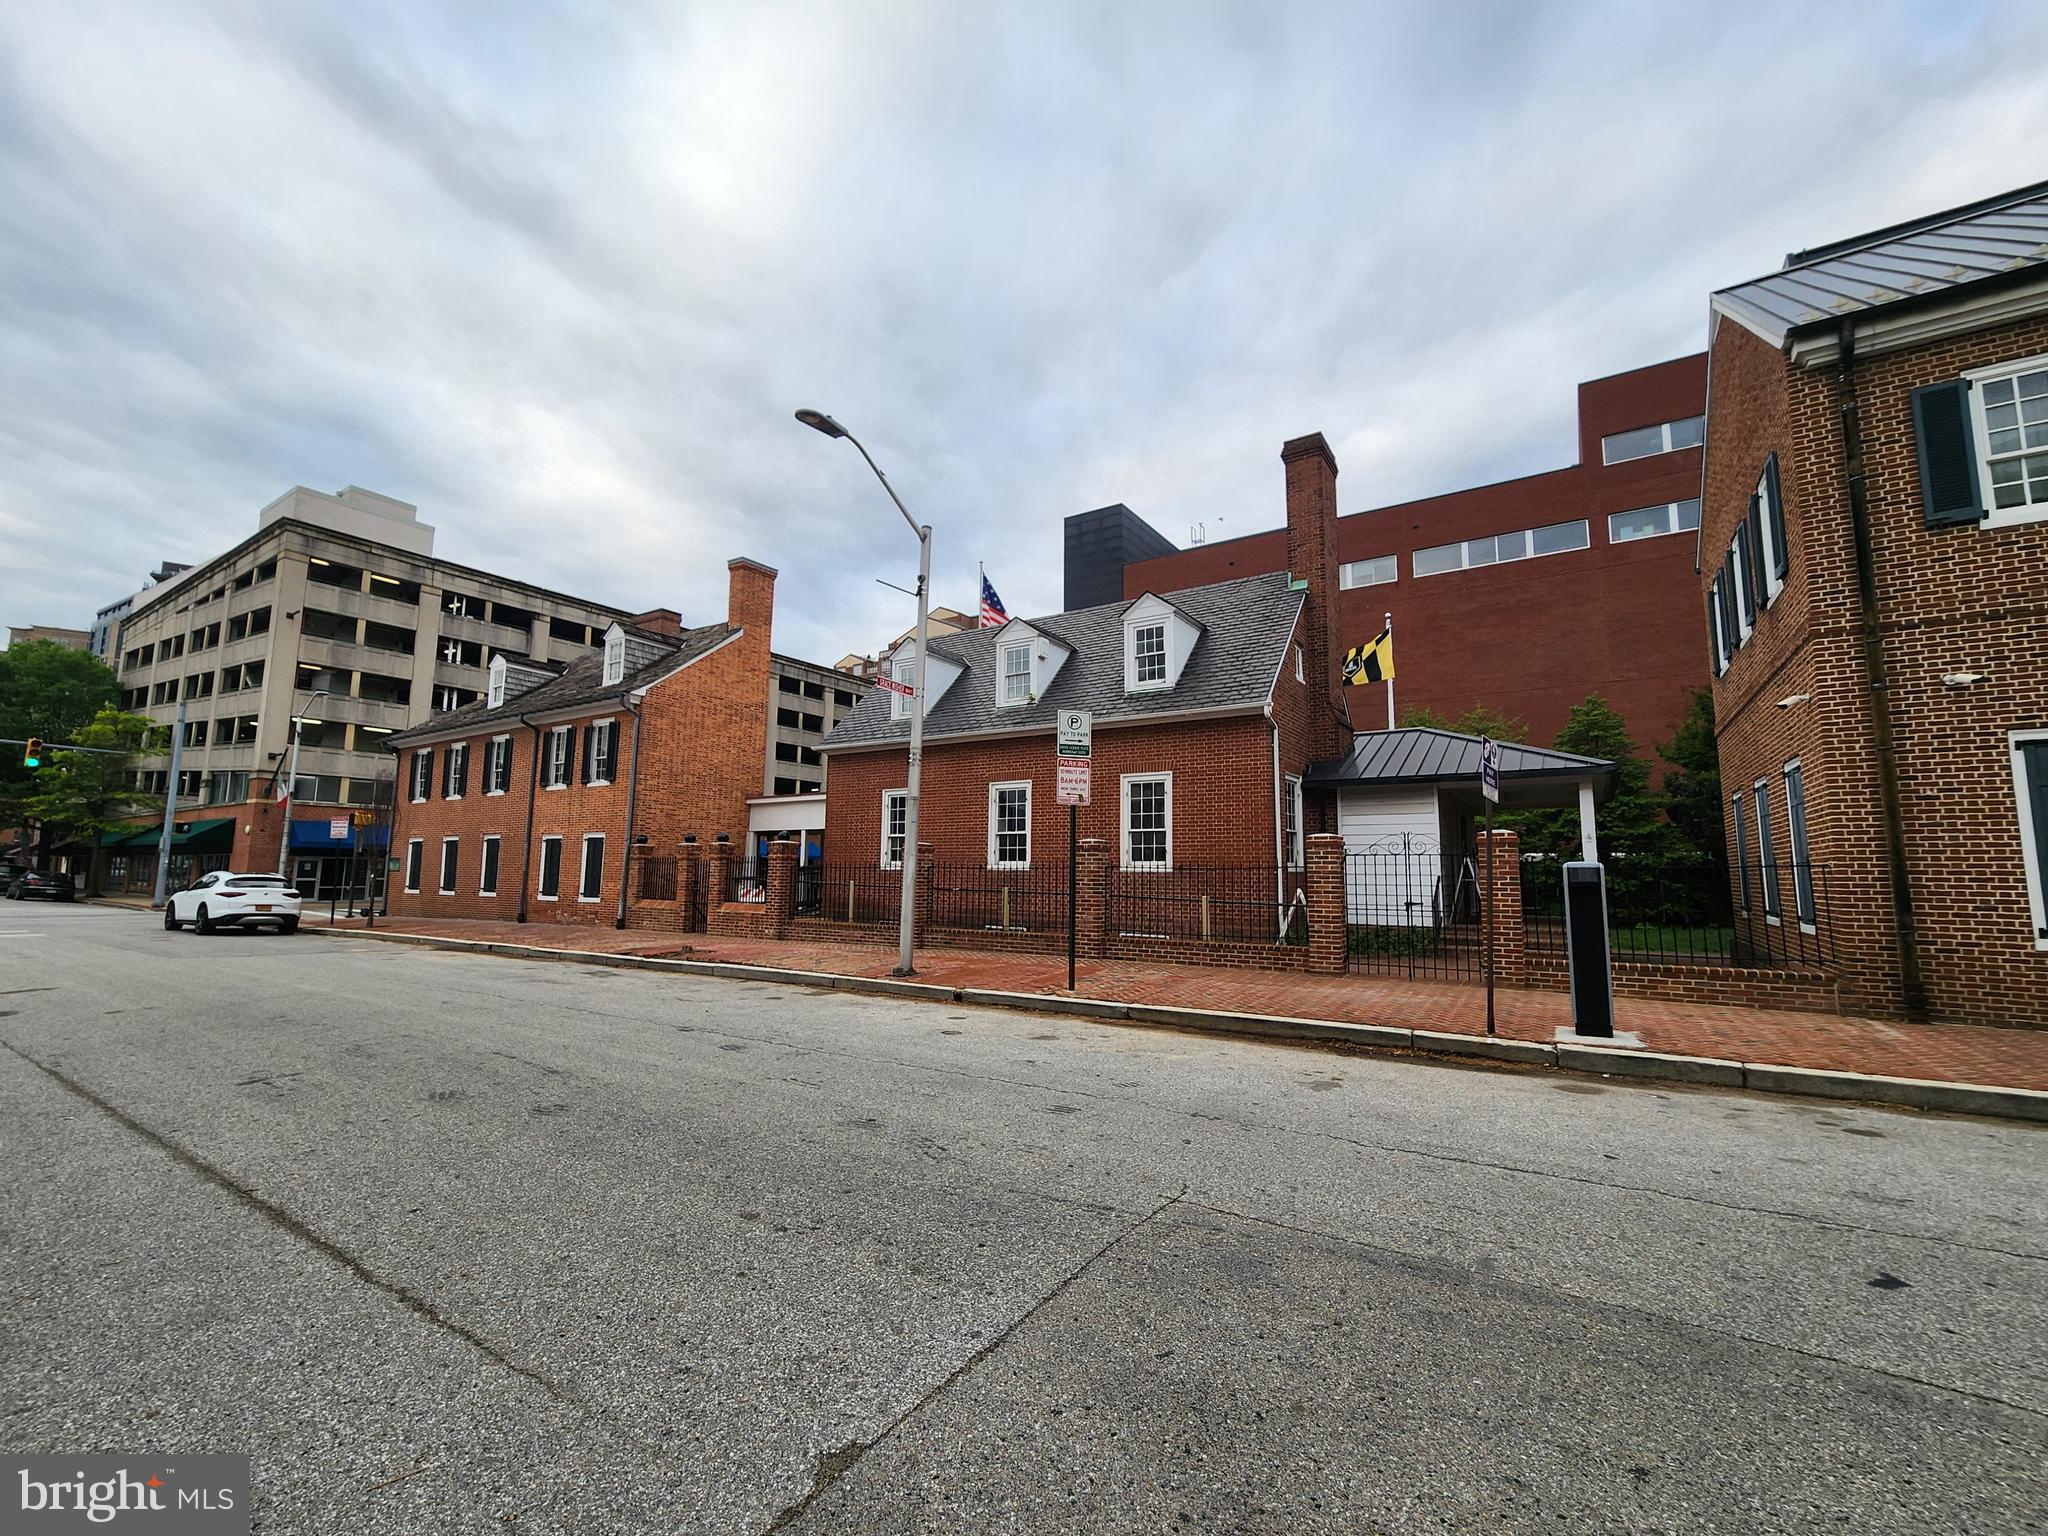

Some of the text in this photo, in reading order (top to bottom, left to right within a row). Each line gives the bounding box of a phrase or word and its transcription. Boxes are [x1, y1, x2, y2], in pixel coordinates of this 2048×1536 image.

[1060, 759, 1088, 768] PARKING
[1486, 767, 1494, 776] PAY
[1060, 776, 1087, 785] 8AM-6PM
[1485, 776, 1496, 787] HERE
